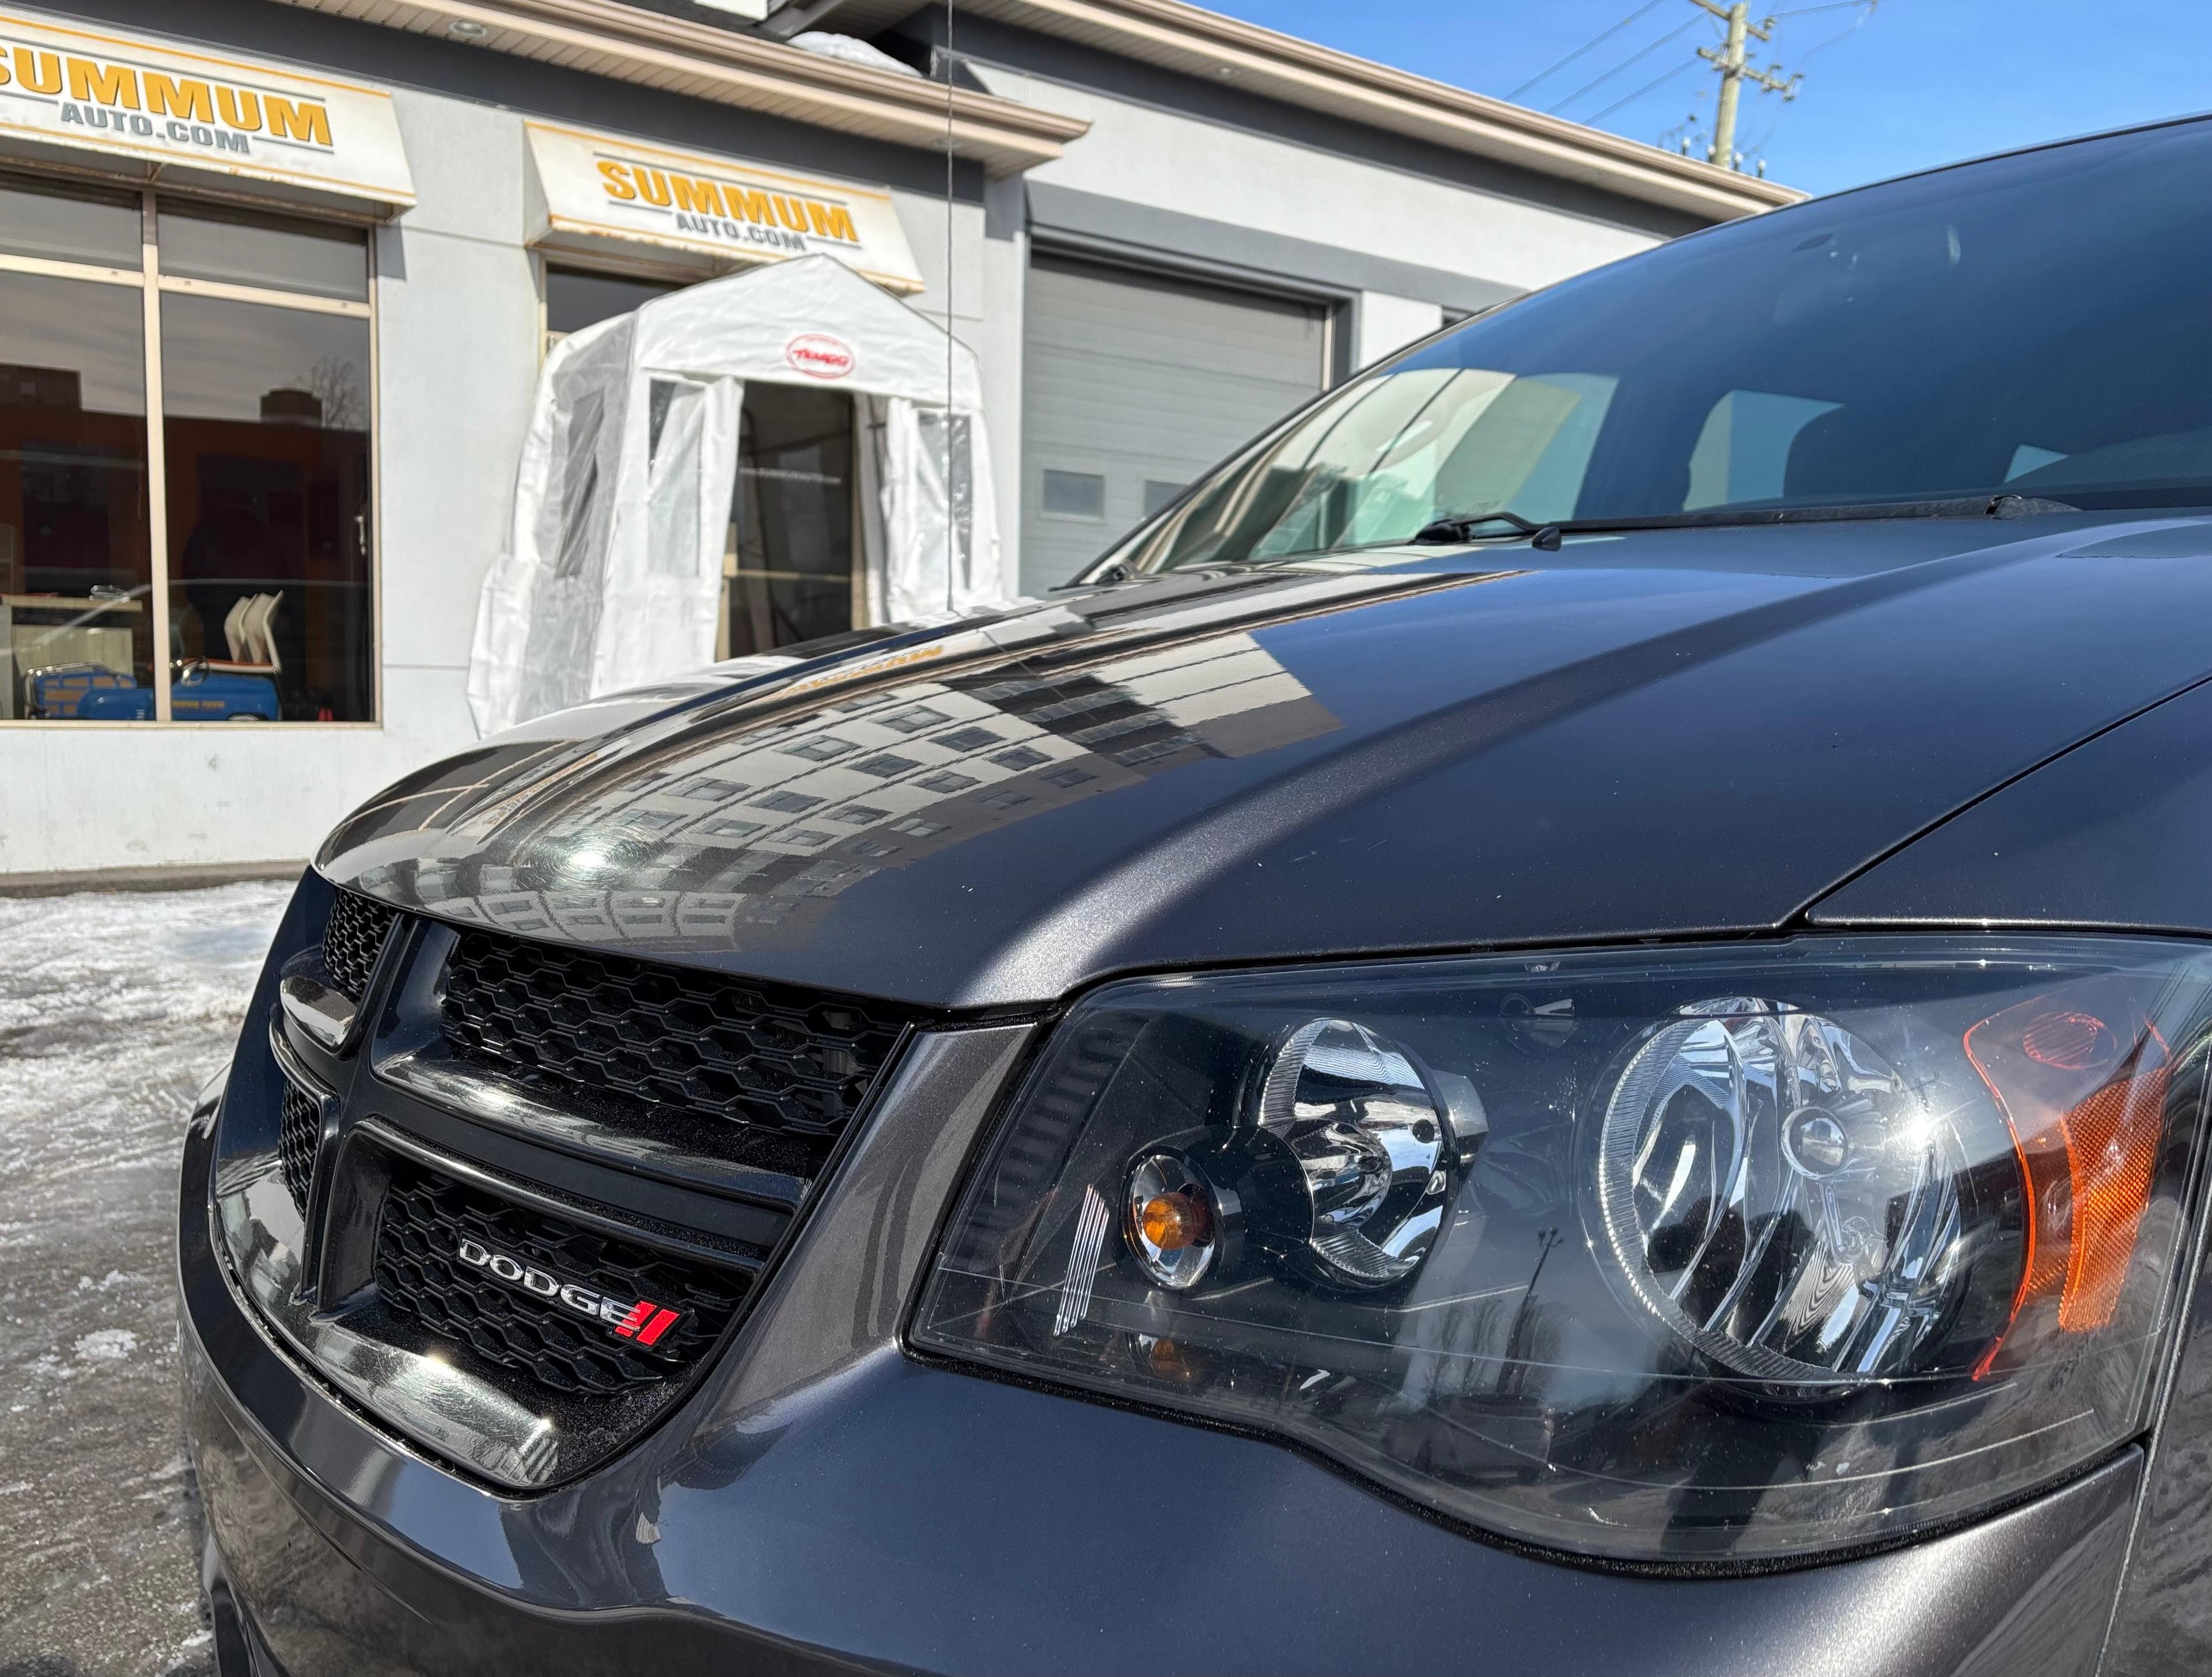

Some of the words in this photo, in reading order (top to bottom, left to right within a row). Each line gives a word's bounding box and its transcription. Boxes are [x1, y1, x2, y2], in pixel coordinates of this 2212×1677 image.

[0, 45, 333, 146] UMMUM
[62, 102, 249, 153] AUTO.COM
[596, 160, 859, 242] SUMMUM
[676, 213, 806, 251] AUTO.COM
[460, 1238, 641, 1332] DODGE
